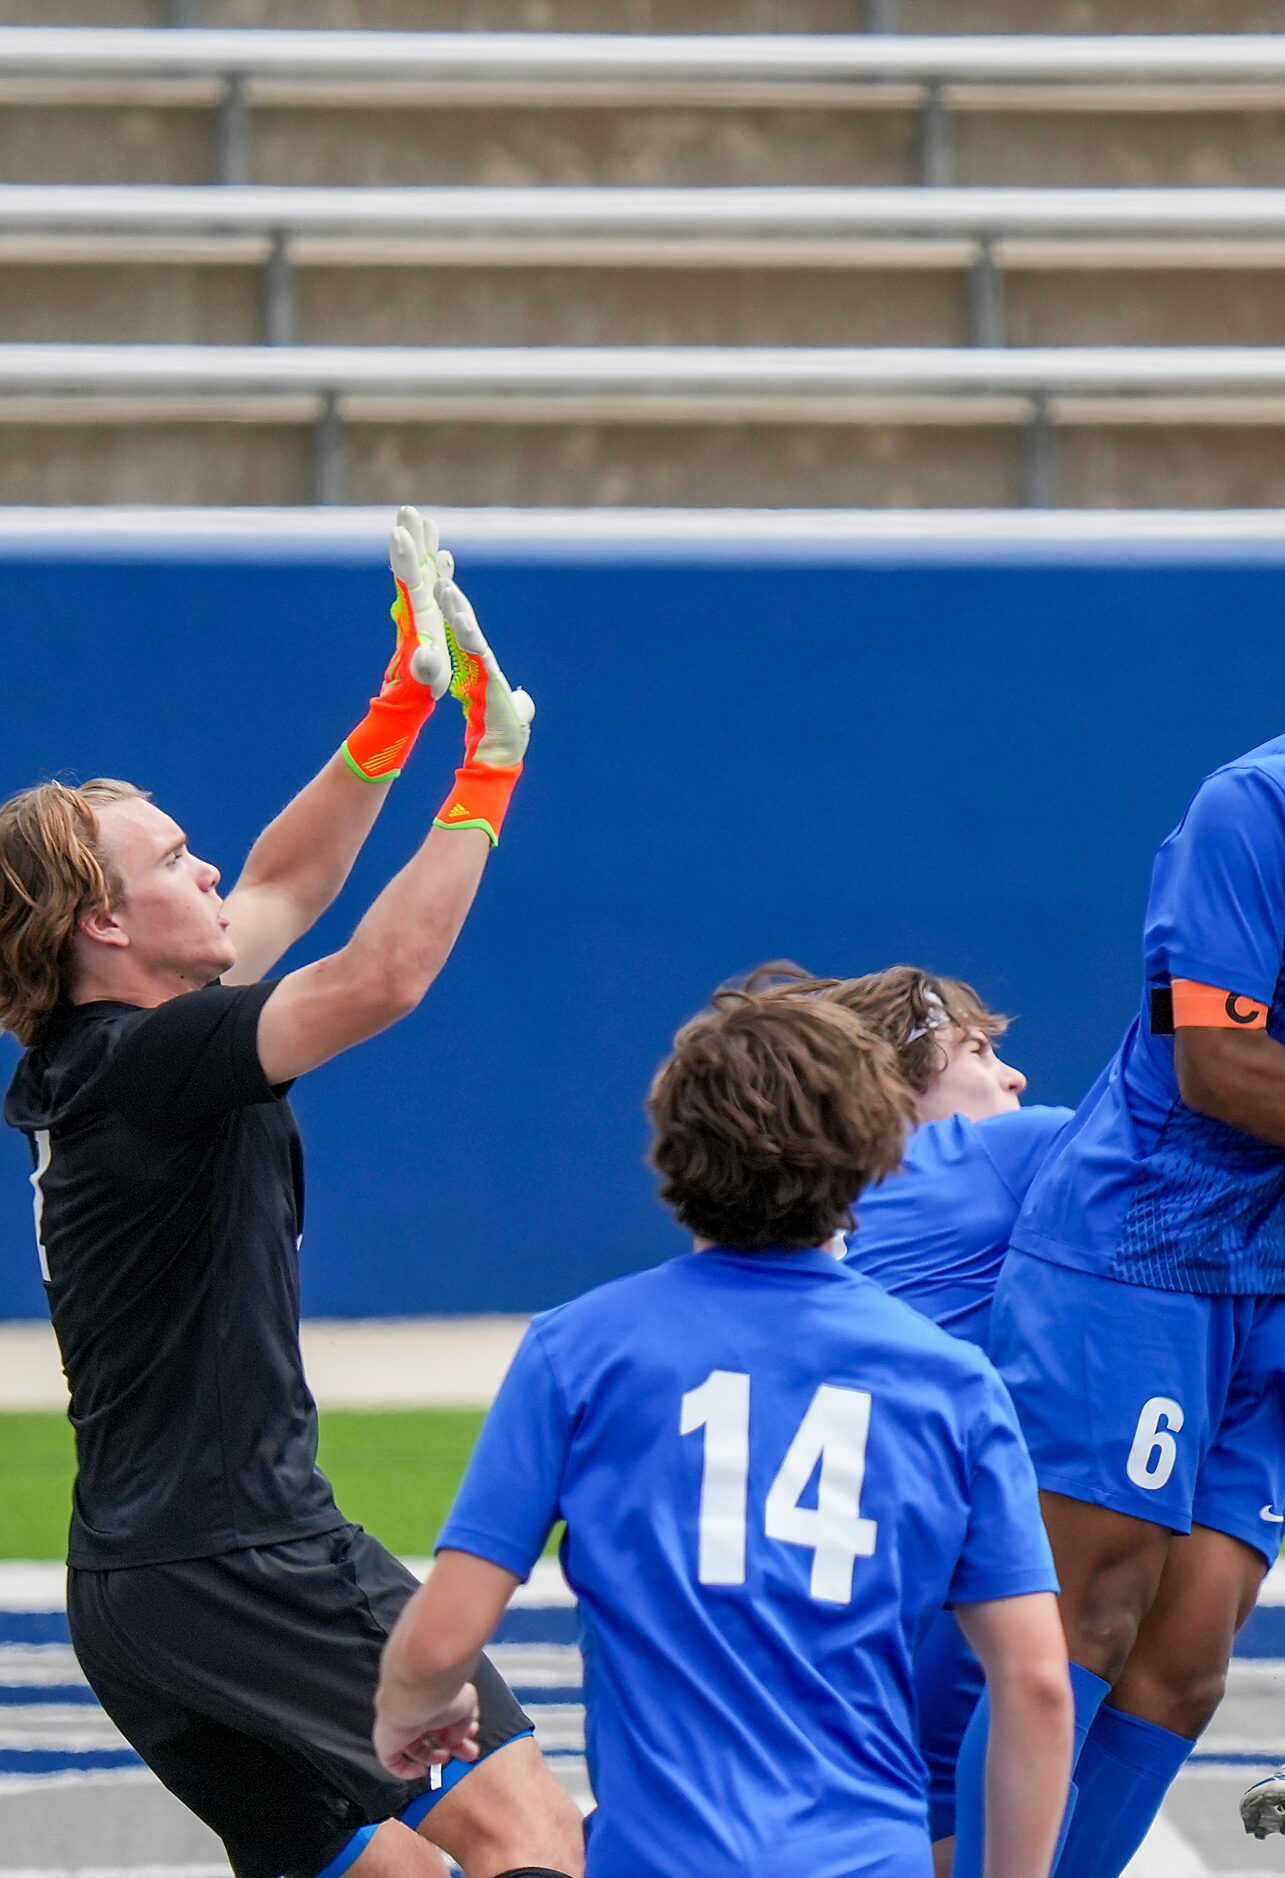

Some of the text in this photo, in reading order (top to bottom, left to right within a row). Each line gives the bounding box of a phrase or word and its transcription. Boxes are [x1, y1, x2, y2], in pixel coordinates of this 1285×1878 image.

[1225, 992, 1259, 1025] C
[679, 1369, 879, 1605] 14
[1126, 1396, 1185, 1491] 6
